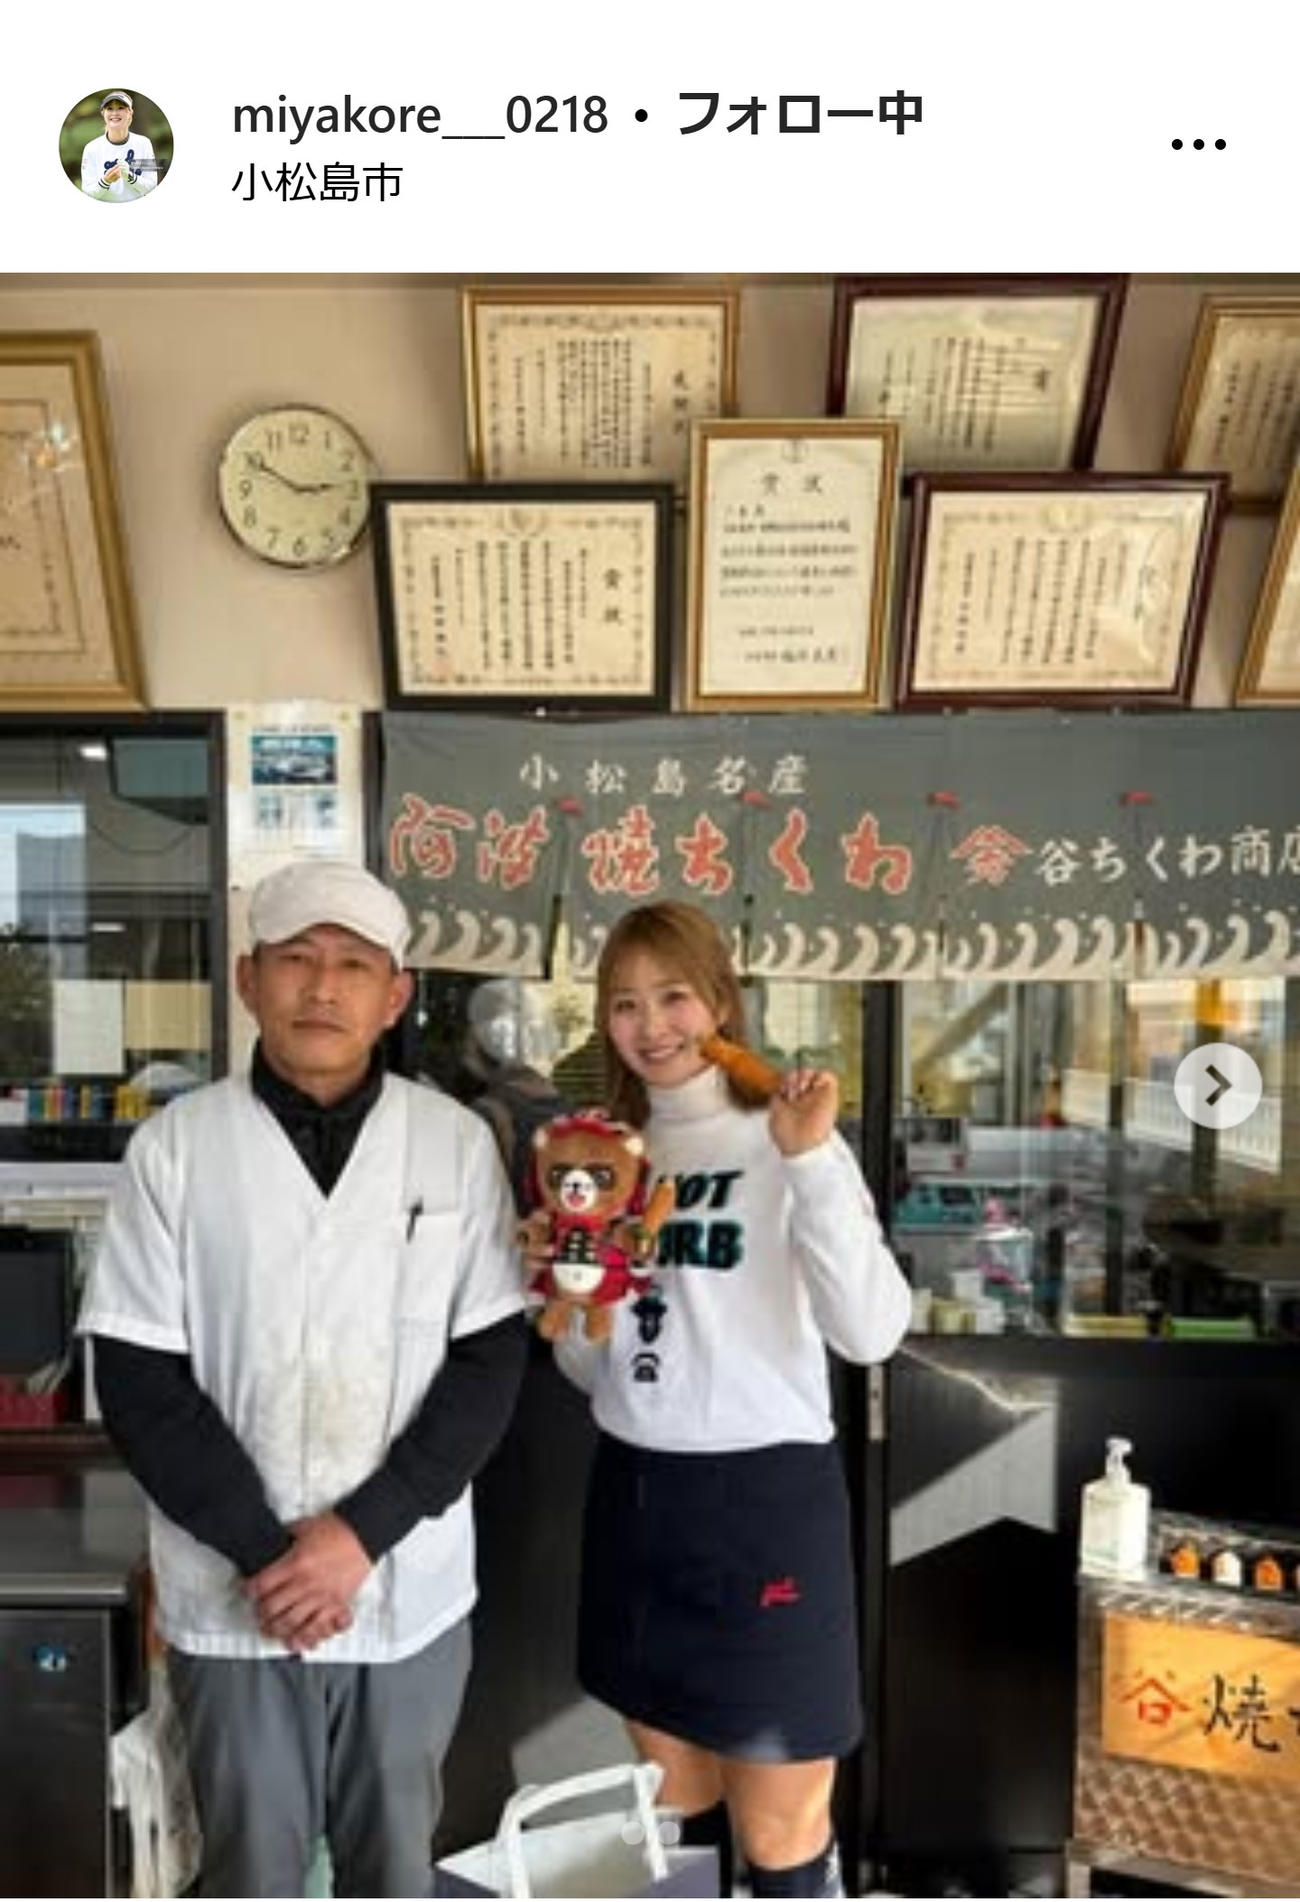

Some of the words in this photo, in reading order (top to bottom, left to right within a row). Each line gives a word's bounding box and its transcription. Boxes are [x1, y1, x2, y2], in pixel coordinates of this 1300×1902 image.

[265, 429, 282, 453] 11
[288, 423, 310, 445] 12
[239, 479, 252, 501] 9
[242, 504, 257, 529] 8
[266, 526, 281, 549] 7
[292, 536, 308, 557] 6
[519, 752, 807, 798] 小松島名産
[1202, 1672, 1300, 1753] 焼
